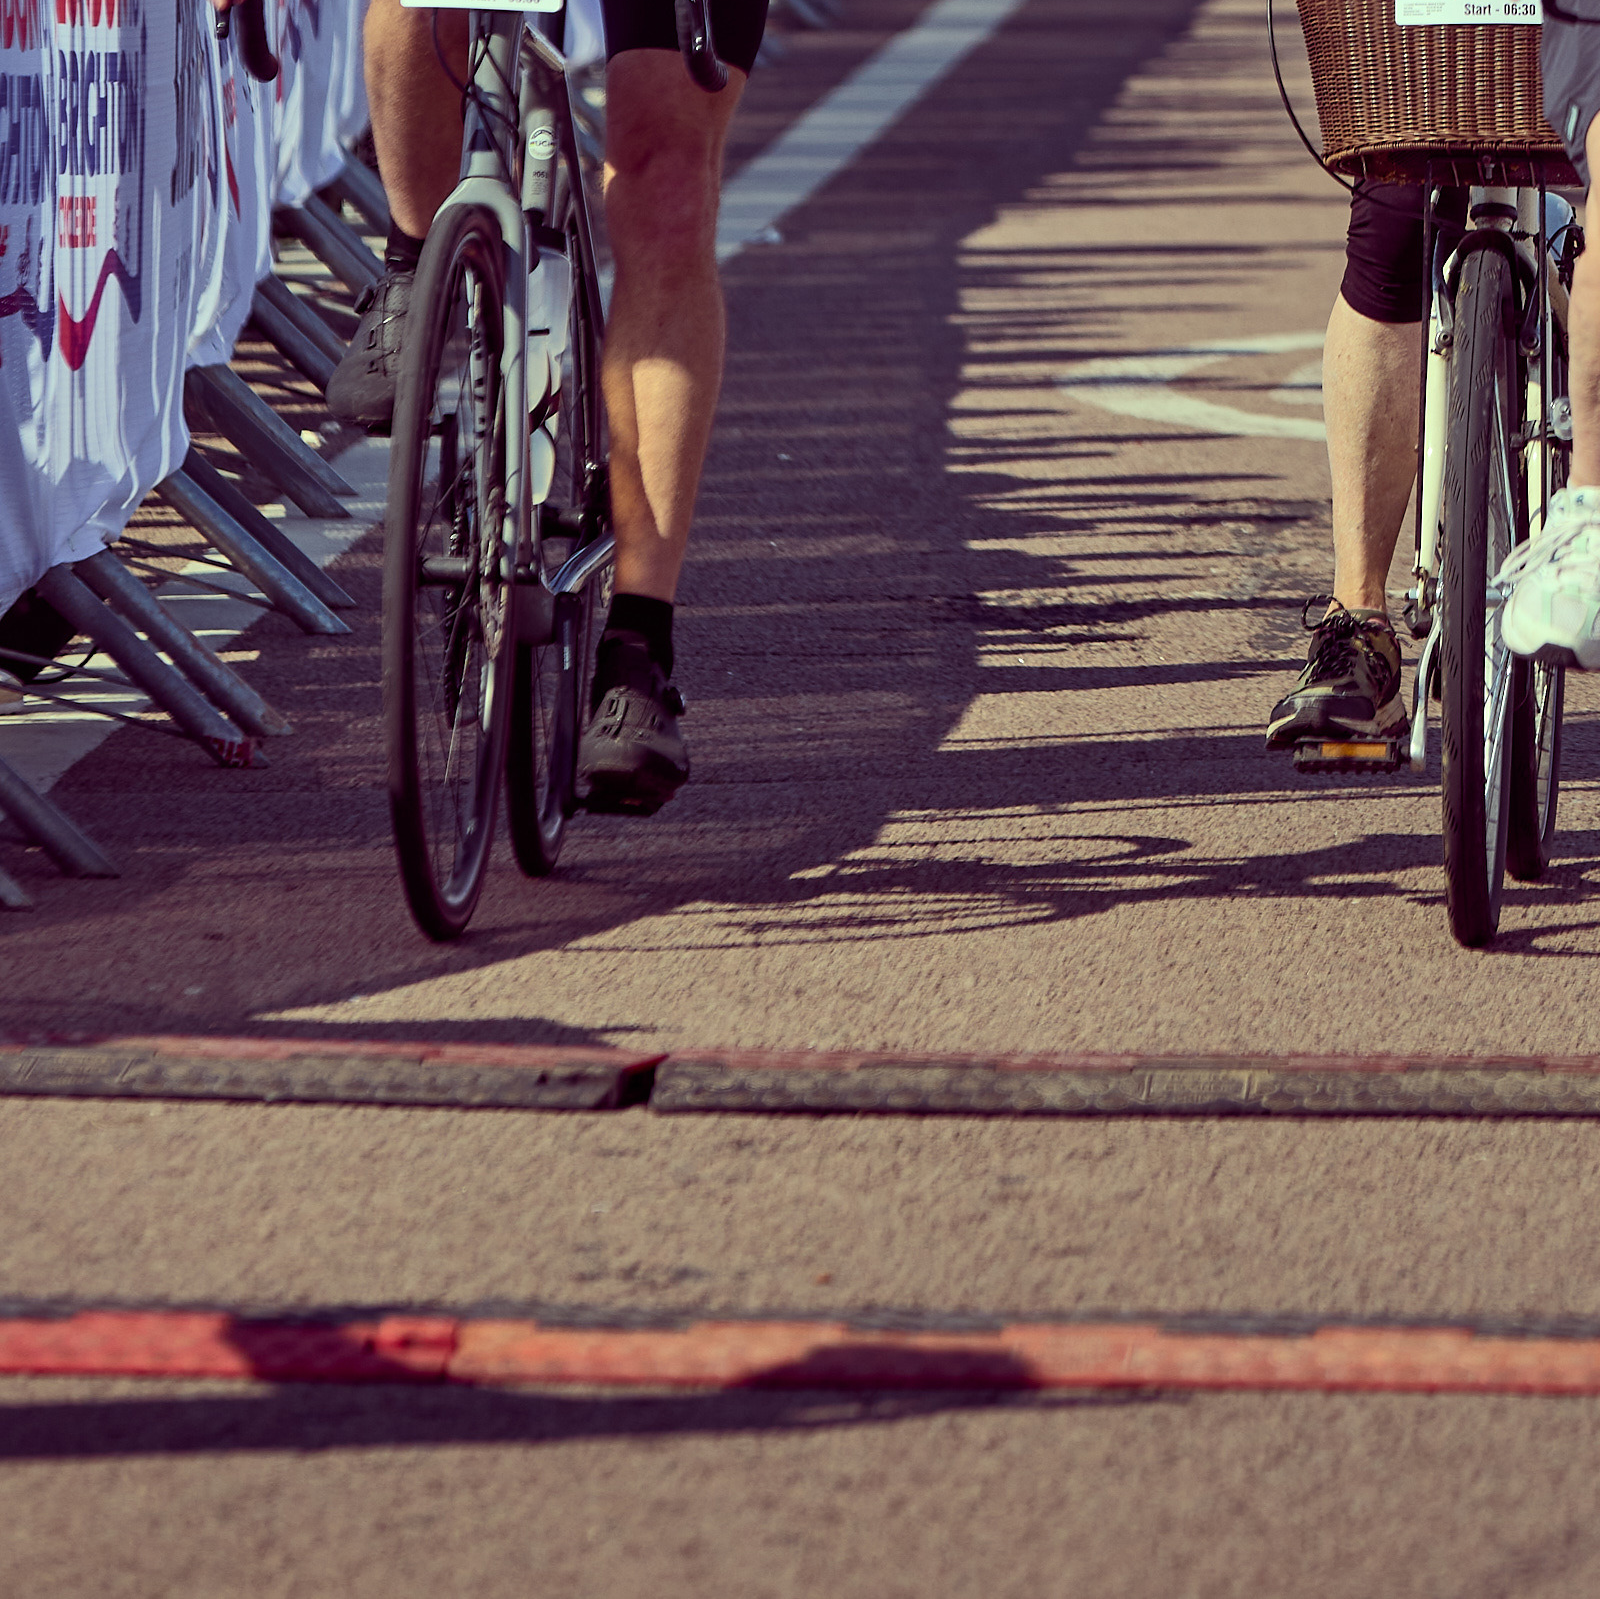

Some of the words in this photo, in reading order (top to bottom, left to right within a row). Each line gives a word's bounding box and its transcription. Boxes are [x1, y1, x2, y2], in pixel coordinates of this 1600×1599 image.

[1463, 3, 1492, 16] Start
[1503, 3, 1537, 17] 06:30
[58, 49, 140, 177] BRIGHTON
